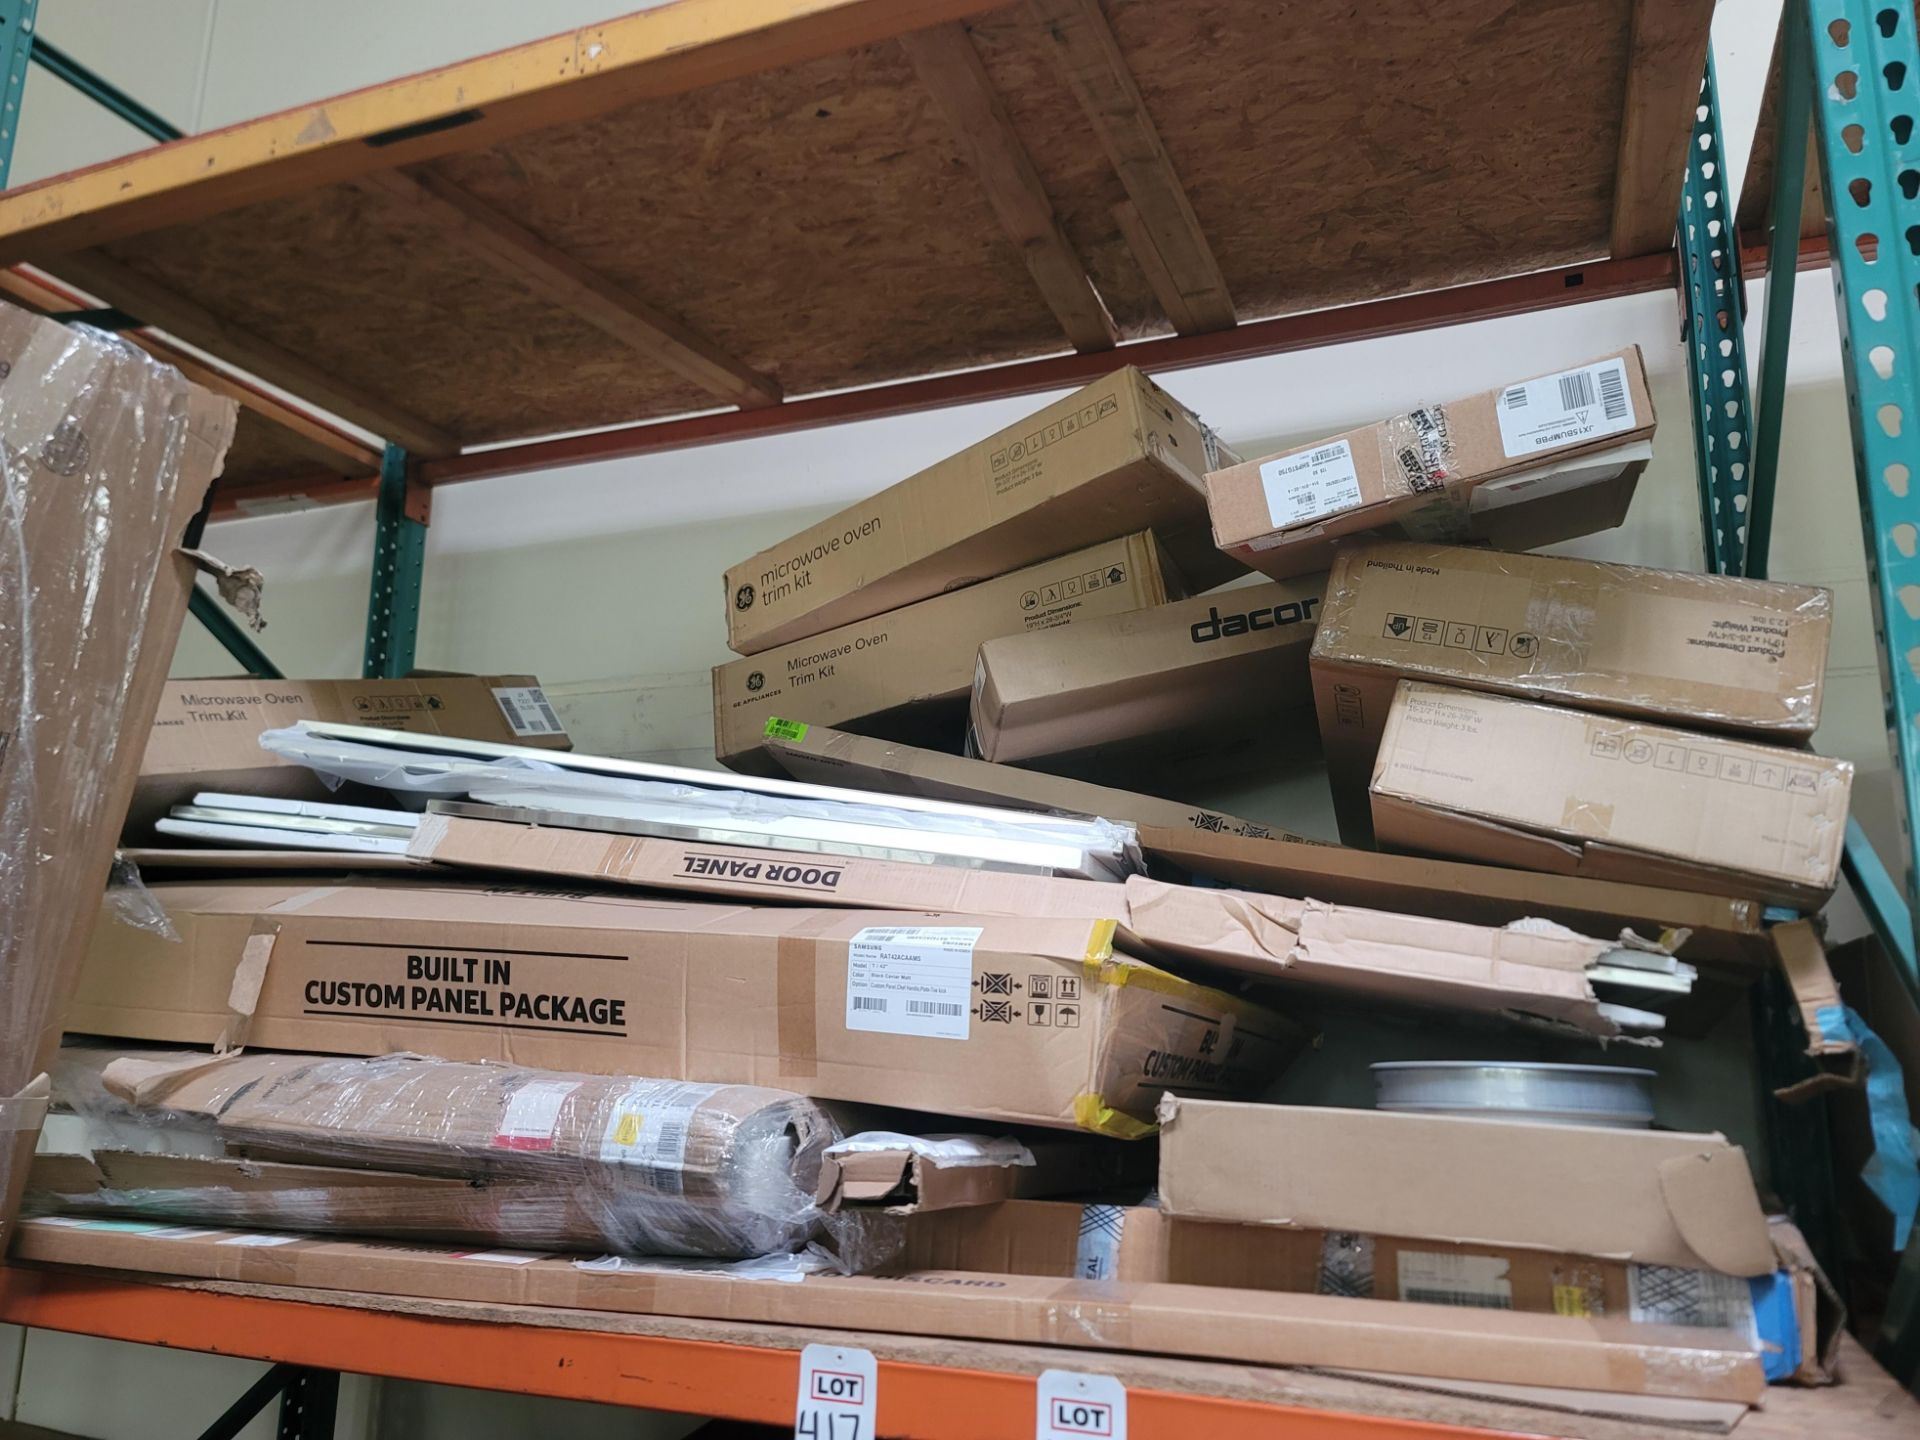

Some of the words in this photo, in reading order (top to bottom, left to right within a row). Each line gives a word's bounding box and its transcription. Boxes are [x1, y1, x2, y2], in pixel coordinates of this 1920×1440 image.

[1404, 449, 1424, 474] BEST
[760, 537, 840, 587] microwave
[844, 517, 881, 545] oven
[1366, 560, 1404, 572] Thailand
[1416, 566, 1440, 575] Made
[762, 581, 792, 607] trim
[795, 570, 812, 591] kit
[1024, 611, 1047, 622] Product
[1190, 598, 1319, 643] dacor
[1751, 625, 1789, 637] Product
[787, 644, 852, 672] Microwave
[855, 632, 888, 650] Oven
[1747, 646, 1786, 658] Product
[788, 673, 815, 688] Trim
[818, 665, 836, 679] Kit
[180, 694, 262, 706] Microwave
[265, 693, 303, 704] Oven
[742, 689, 783, 706] APPLIANCES
[187, 711, 223, 722] Trim
[226, 710, 248, 721] Kit
[683, 856, 762, 879] PANEL
[765, 865, 842, 887] DOOR
[853, 943, 882, 951] SAMSUNG
[407, 955, 479, 983] BUILT
[484, 959, 511, 985] IN
[851, 980, 868, 988] Option
[1035, 981, 1046, 992] 10
[304, 980, 405, 1010] CUSTOM
[411, 986, 494, 1016] PANEL
[500, 992, 626, 1026] PACKAGE
[1143, 1050, 1192, 1081] CUSTOM
[1086, 1255, 1099, 1280] EAL
[817, 1376, 859, 1398] LOT
[798, 1409, 860, 1440] 417
[1058, 1404, 1105, 1428] LOT
